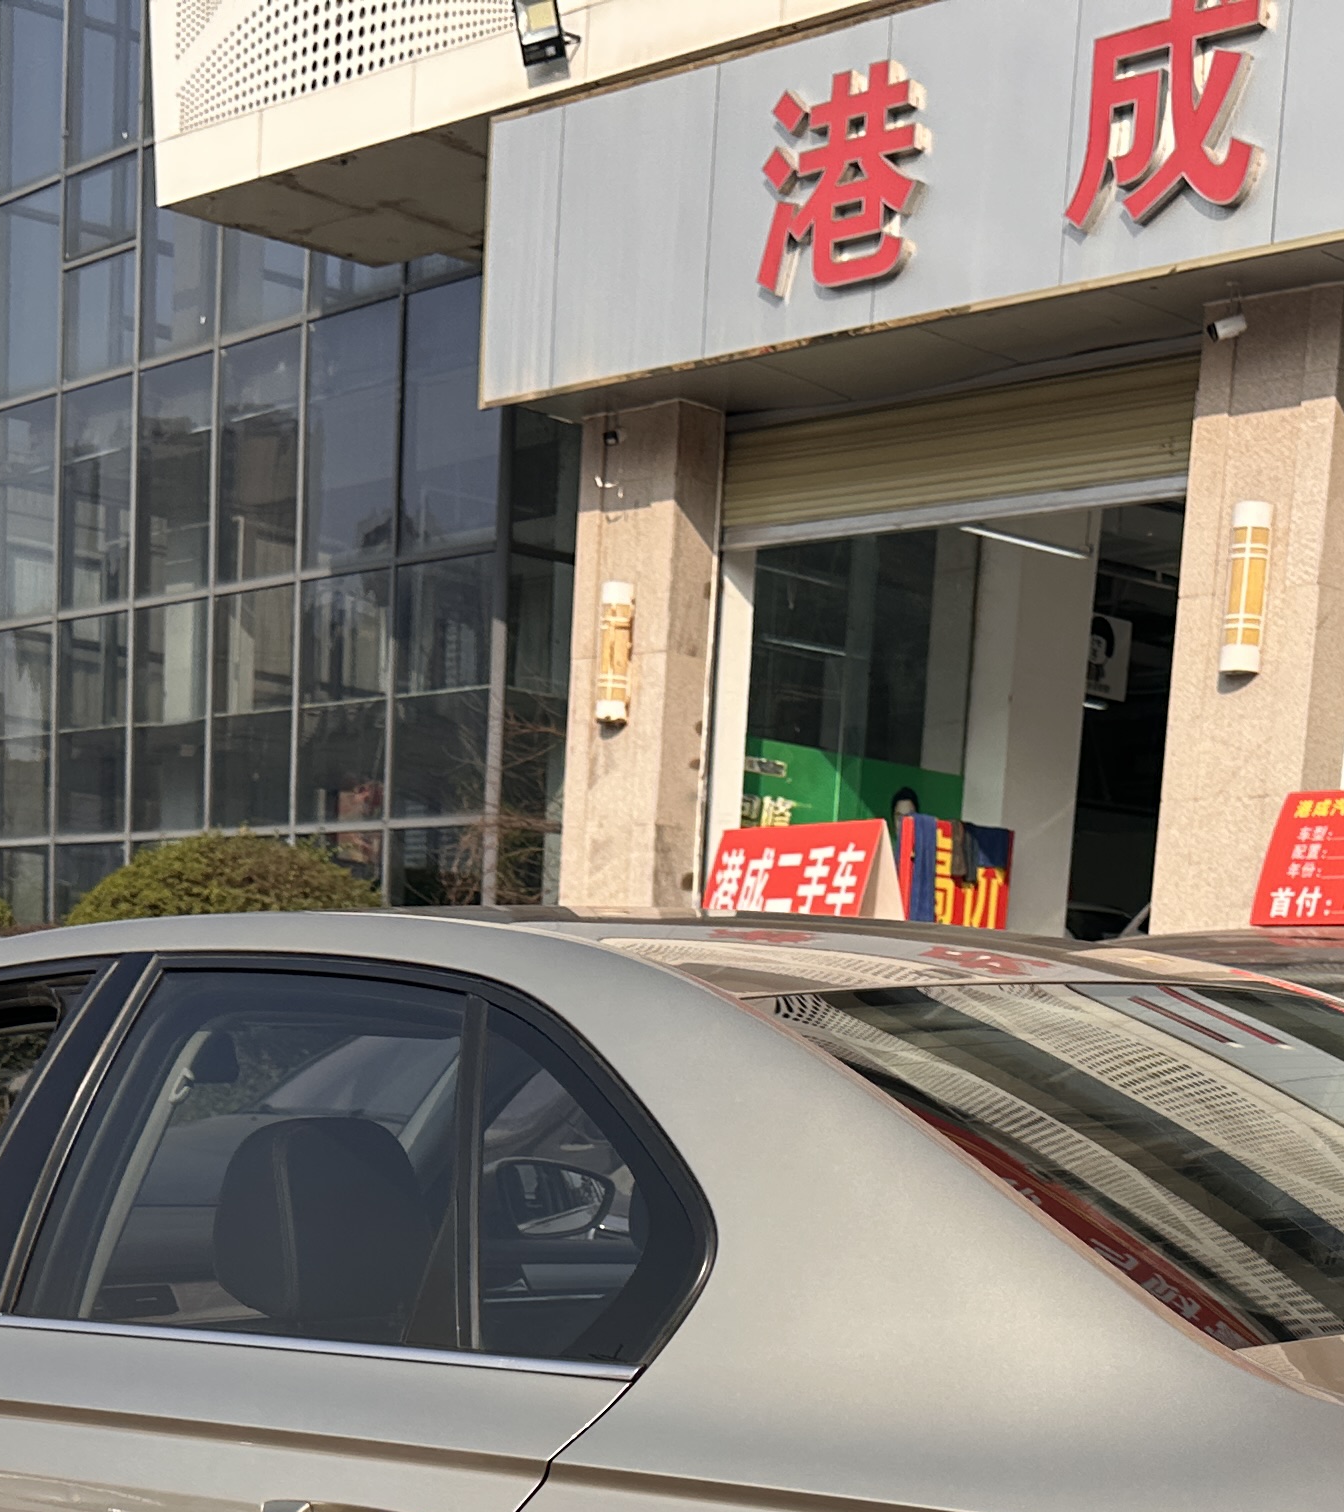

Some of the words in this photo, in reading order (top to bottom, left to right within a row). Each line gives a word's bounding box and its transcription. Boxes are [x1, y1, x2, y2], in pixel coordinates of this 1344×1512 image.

[710, 844, 866, 916] 港成二手车
